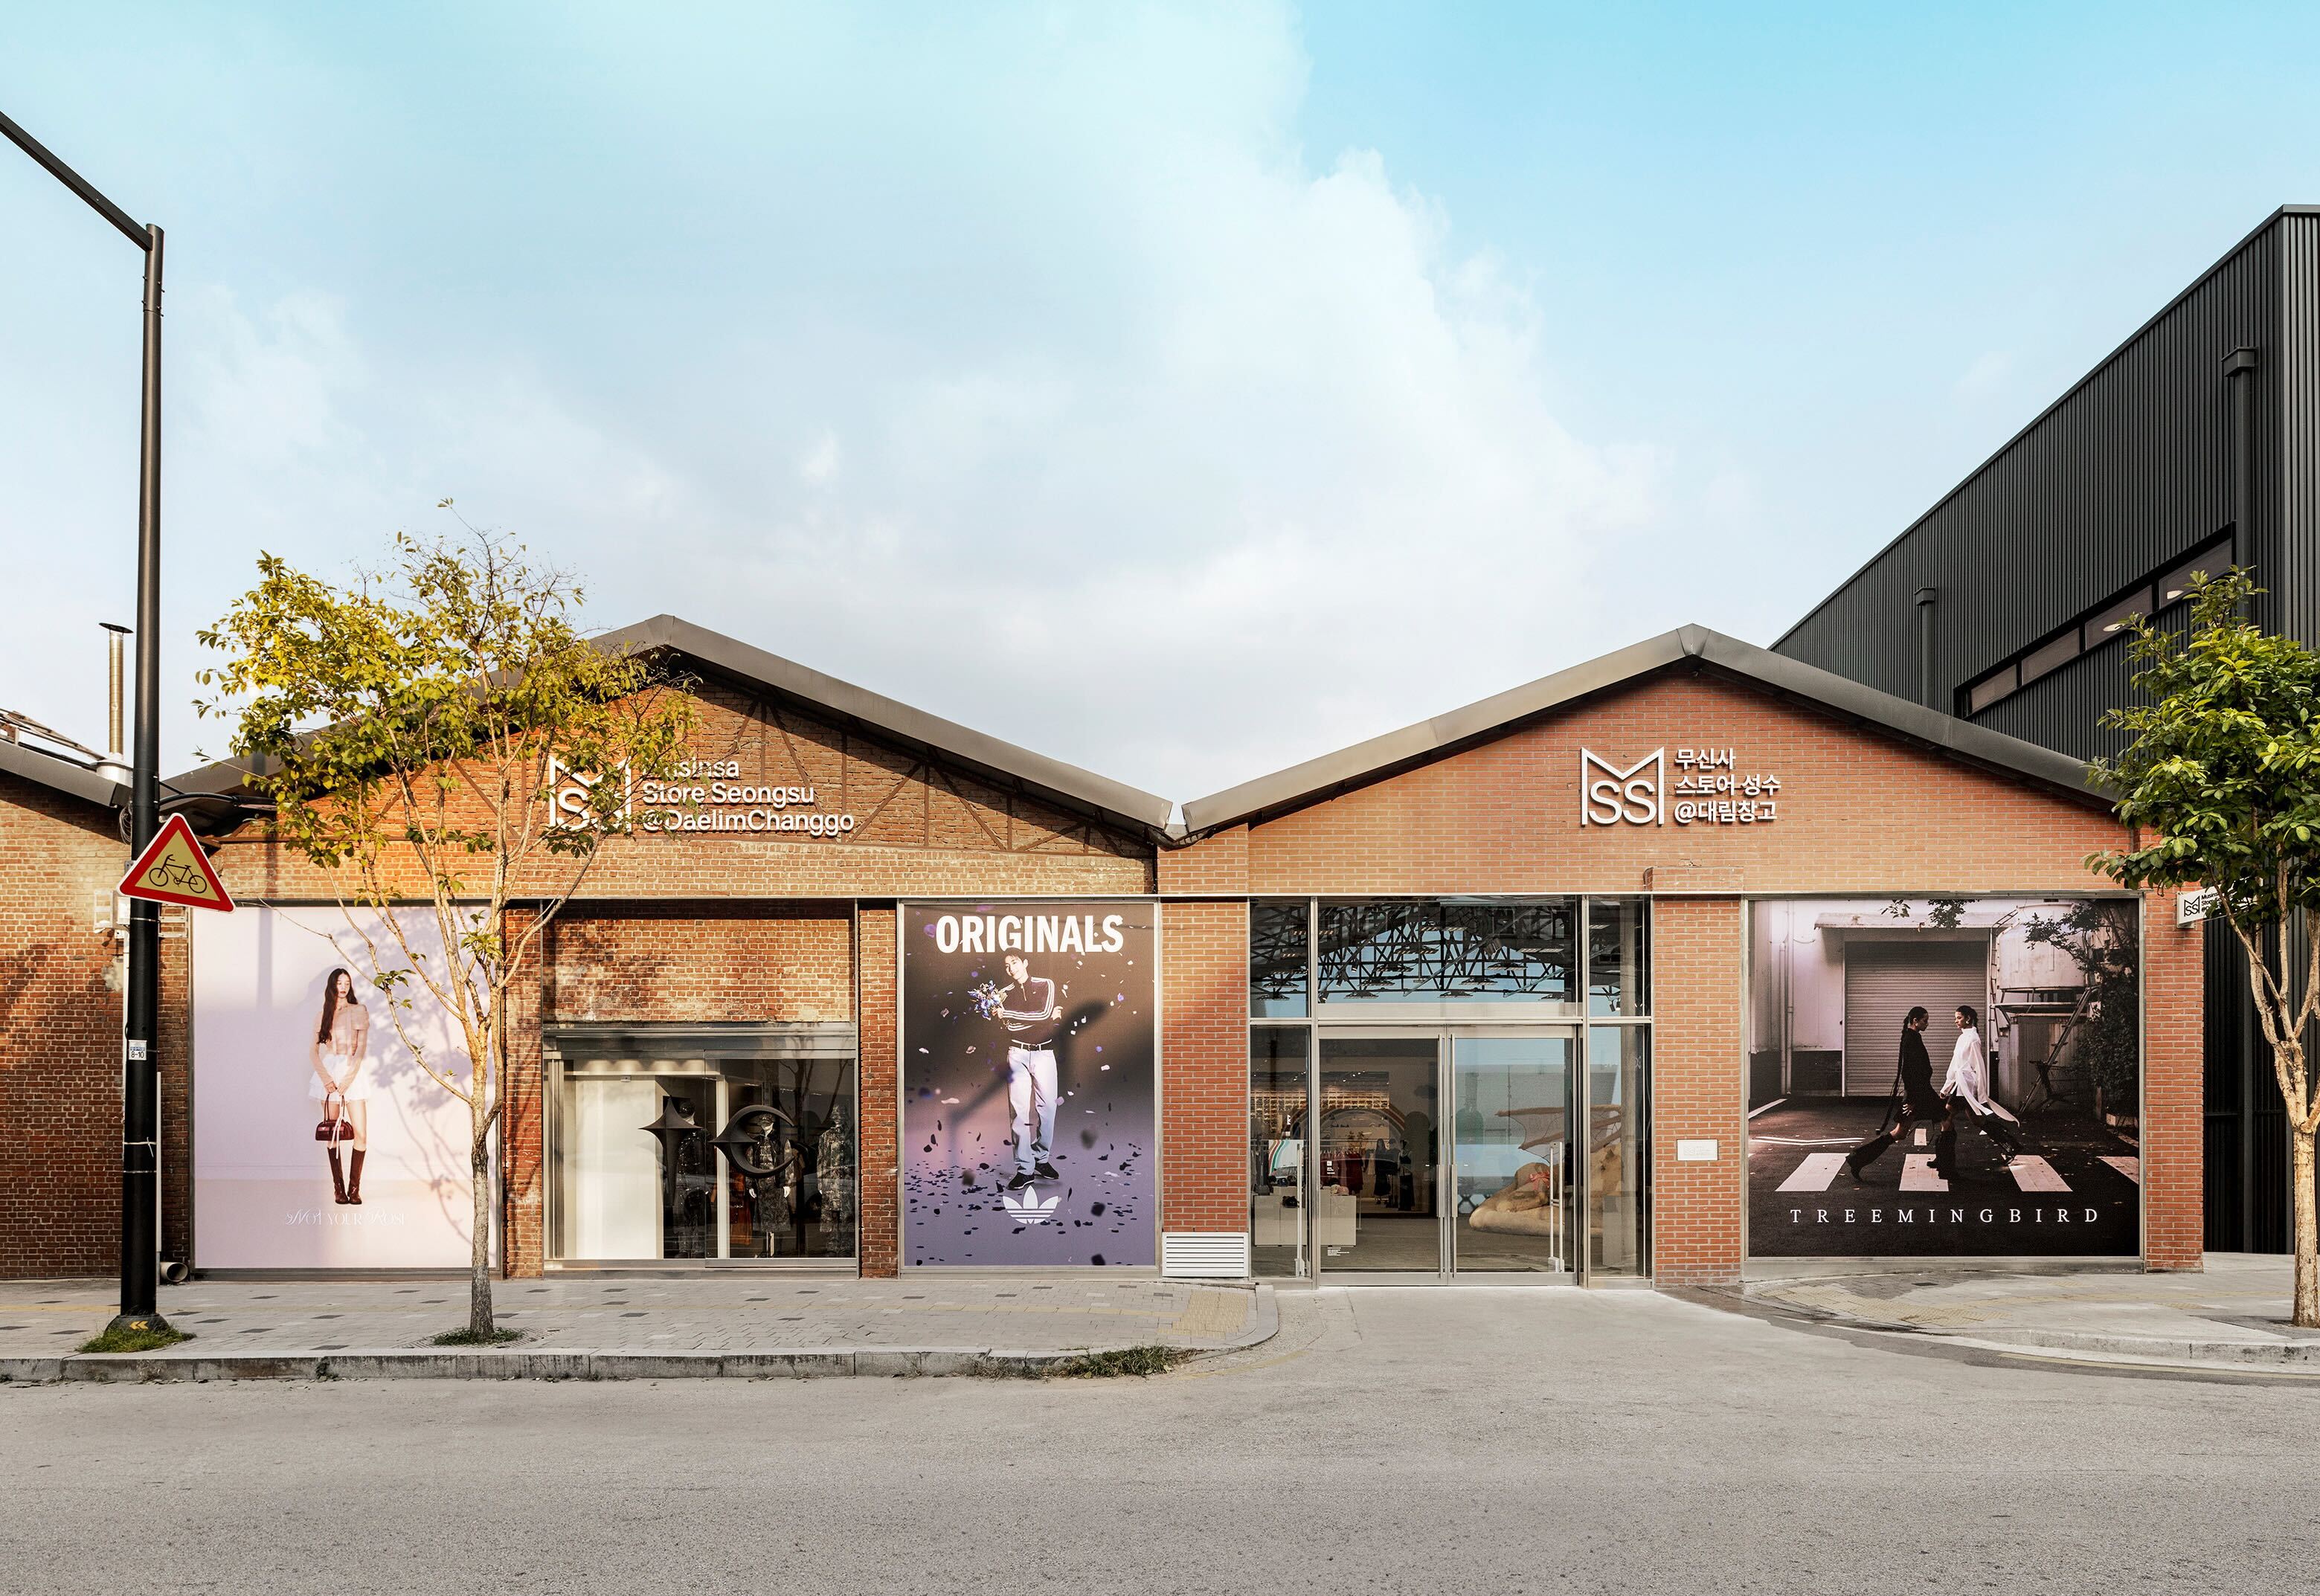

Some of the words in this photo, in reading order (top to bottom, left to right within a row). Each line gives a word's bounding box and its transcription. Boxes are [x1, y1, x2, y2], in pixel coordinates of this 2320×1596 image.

[643, 757, 739, 778] sinsa
[1675, 747, 1736, 770] 무신사
[643, 782, 706, 804] Store
[711, 782, 814, 808] Seongsu
[1581, 746, 1665, 825] MSS
[1675, 774, 1735, 796] 스토어
[1741, 774, 1781, 796] 성수
[642, 808, 855, 837] @DaelimChanggo
[1674, 800, 1778, 823] @대림창고
[936, 914, 1124, 953] ORIGINALS
[1790, 1208, 2098, 1223] TREEMINGBIRD
